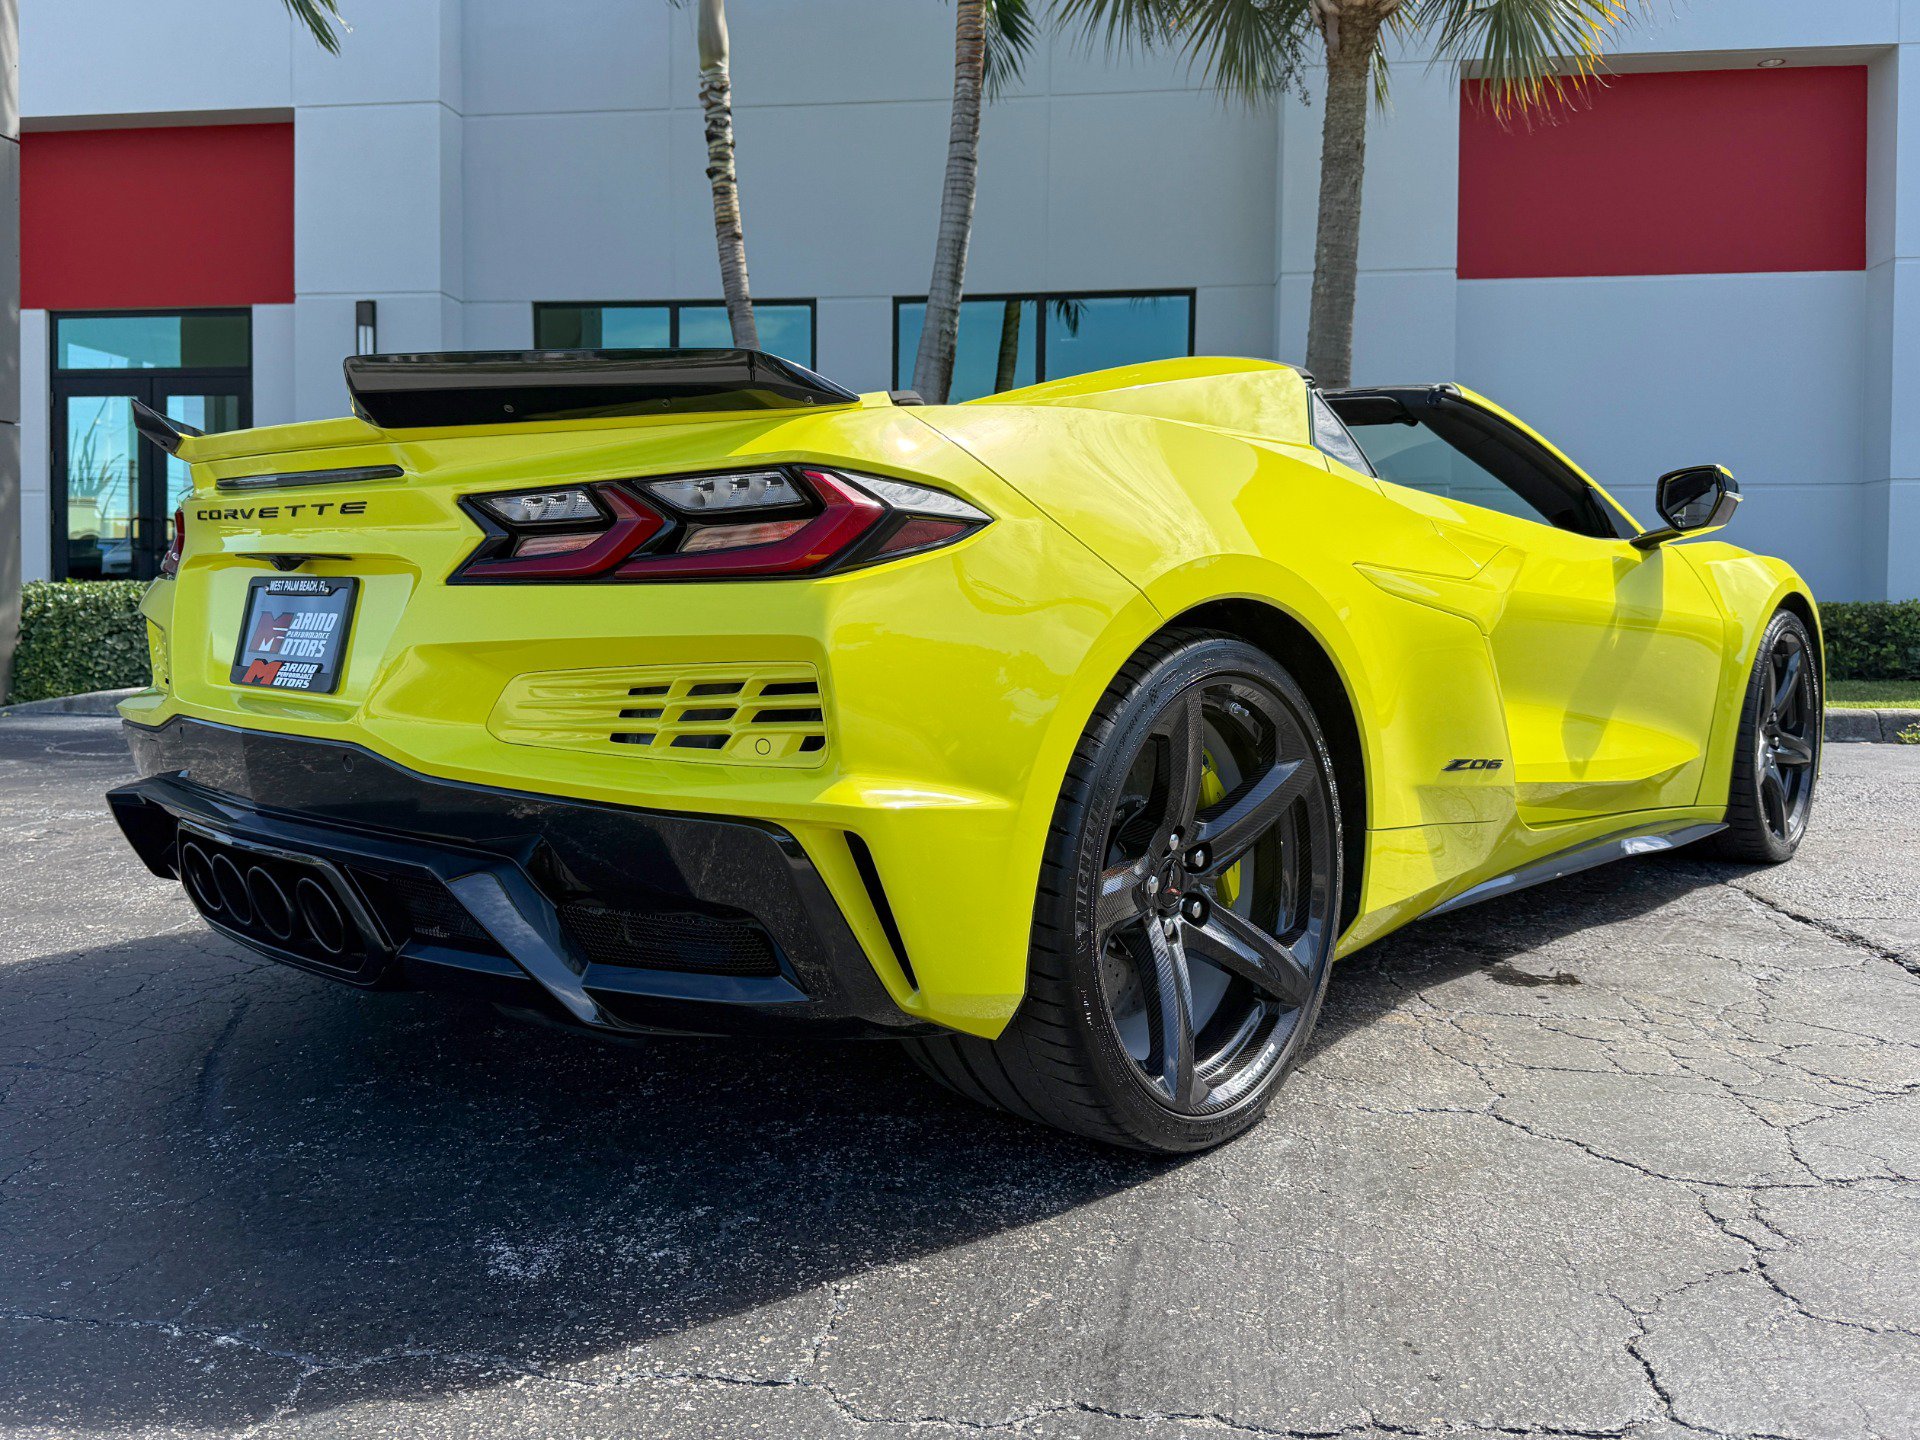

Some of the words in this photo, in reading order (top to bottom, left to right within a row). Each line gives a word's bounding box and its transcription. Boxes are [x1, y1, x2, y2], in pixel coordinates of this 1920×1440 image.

[197, 501, 367, 521] CORVETTE
[270, 580, 285, 591] WEST
[284, 580, 299, 591] PALM
[299, 580, 318, 593] BEACH,
[1441, 759, 1504, 772] Z06
[1233, 1042, 1276, 1089] CORVETTE
